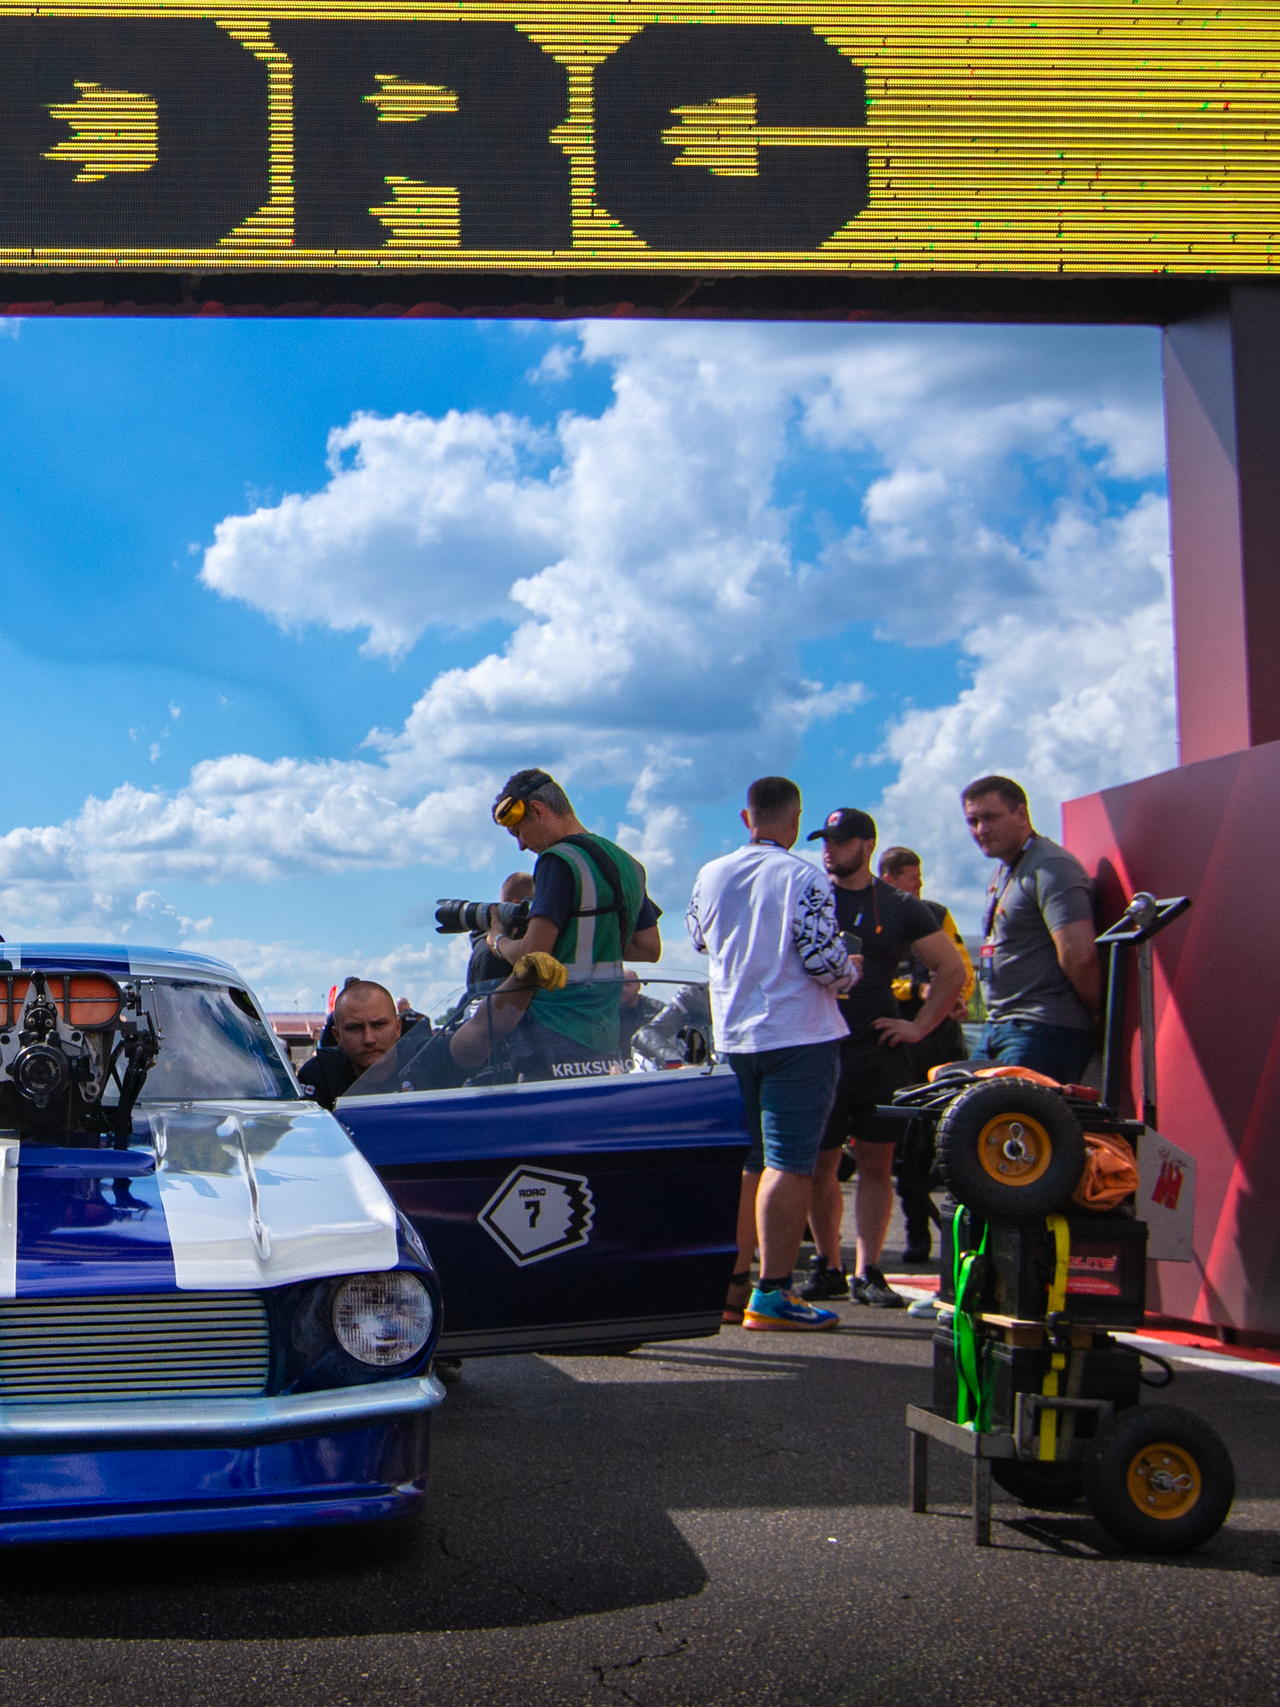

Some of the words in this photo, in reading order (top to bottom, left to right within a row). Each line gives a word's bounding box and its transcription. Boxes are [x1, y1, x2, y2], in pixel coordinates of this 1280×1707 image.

[519, 1188, 546, 1197] RDRC
[524, 1200, 540, 1228] 7
[1068, 1255, 1116, 1270] OLITE
